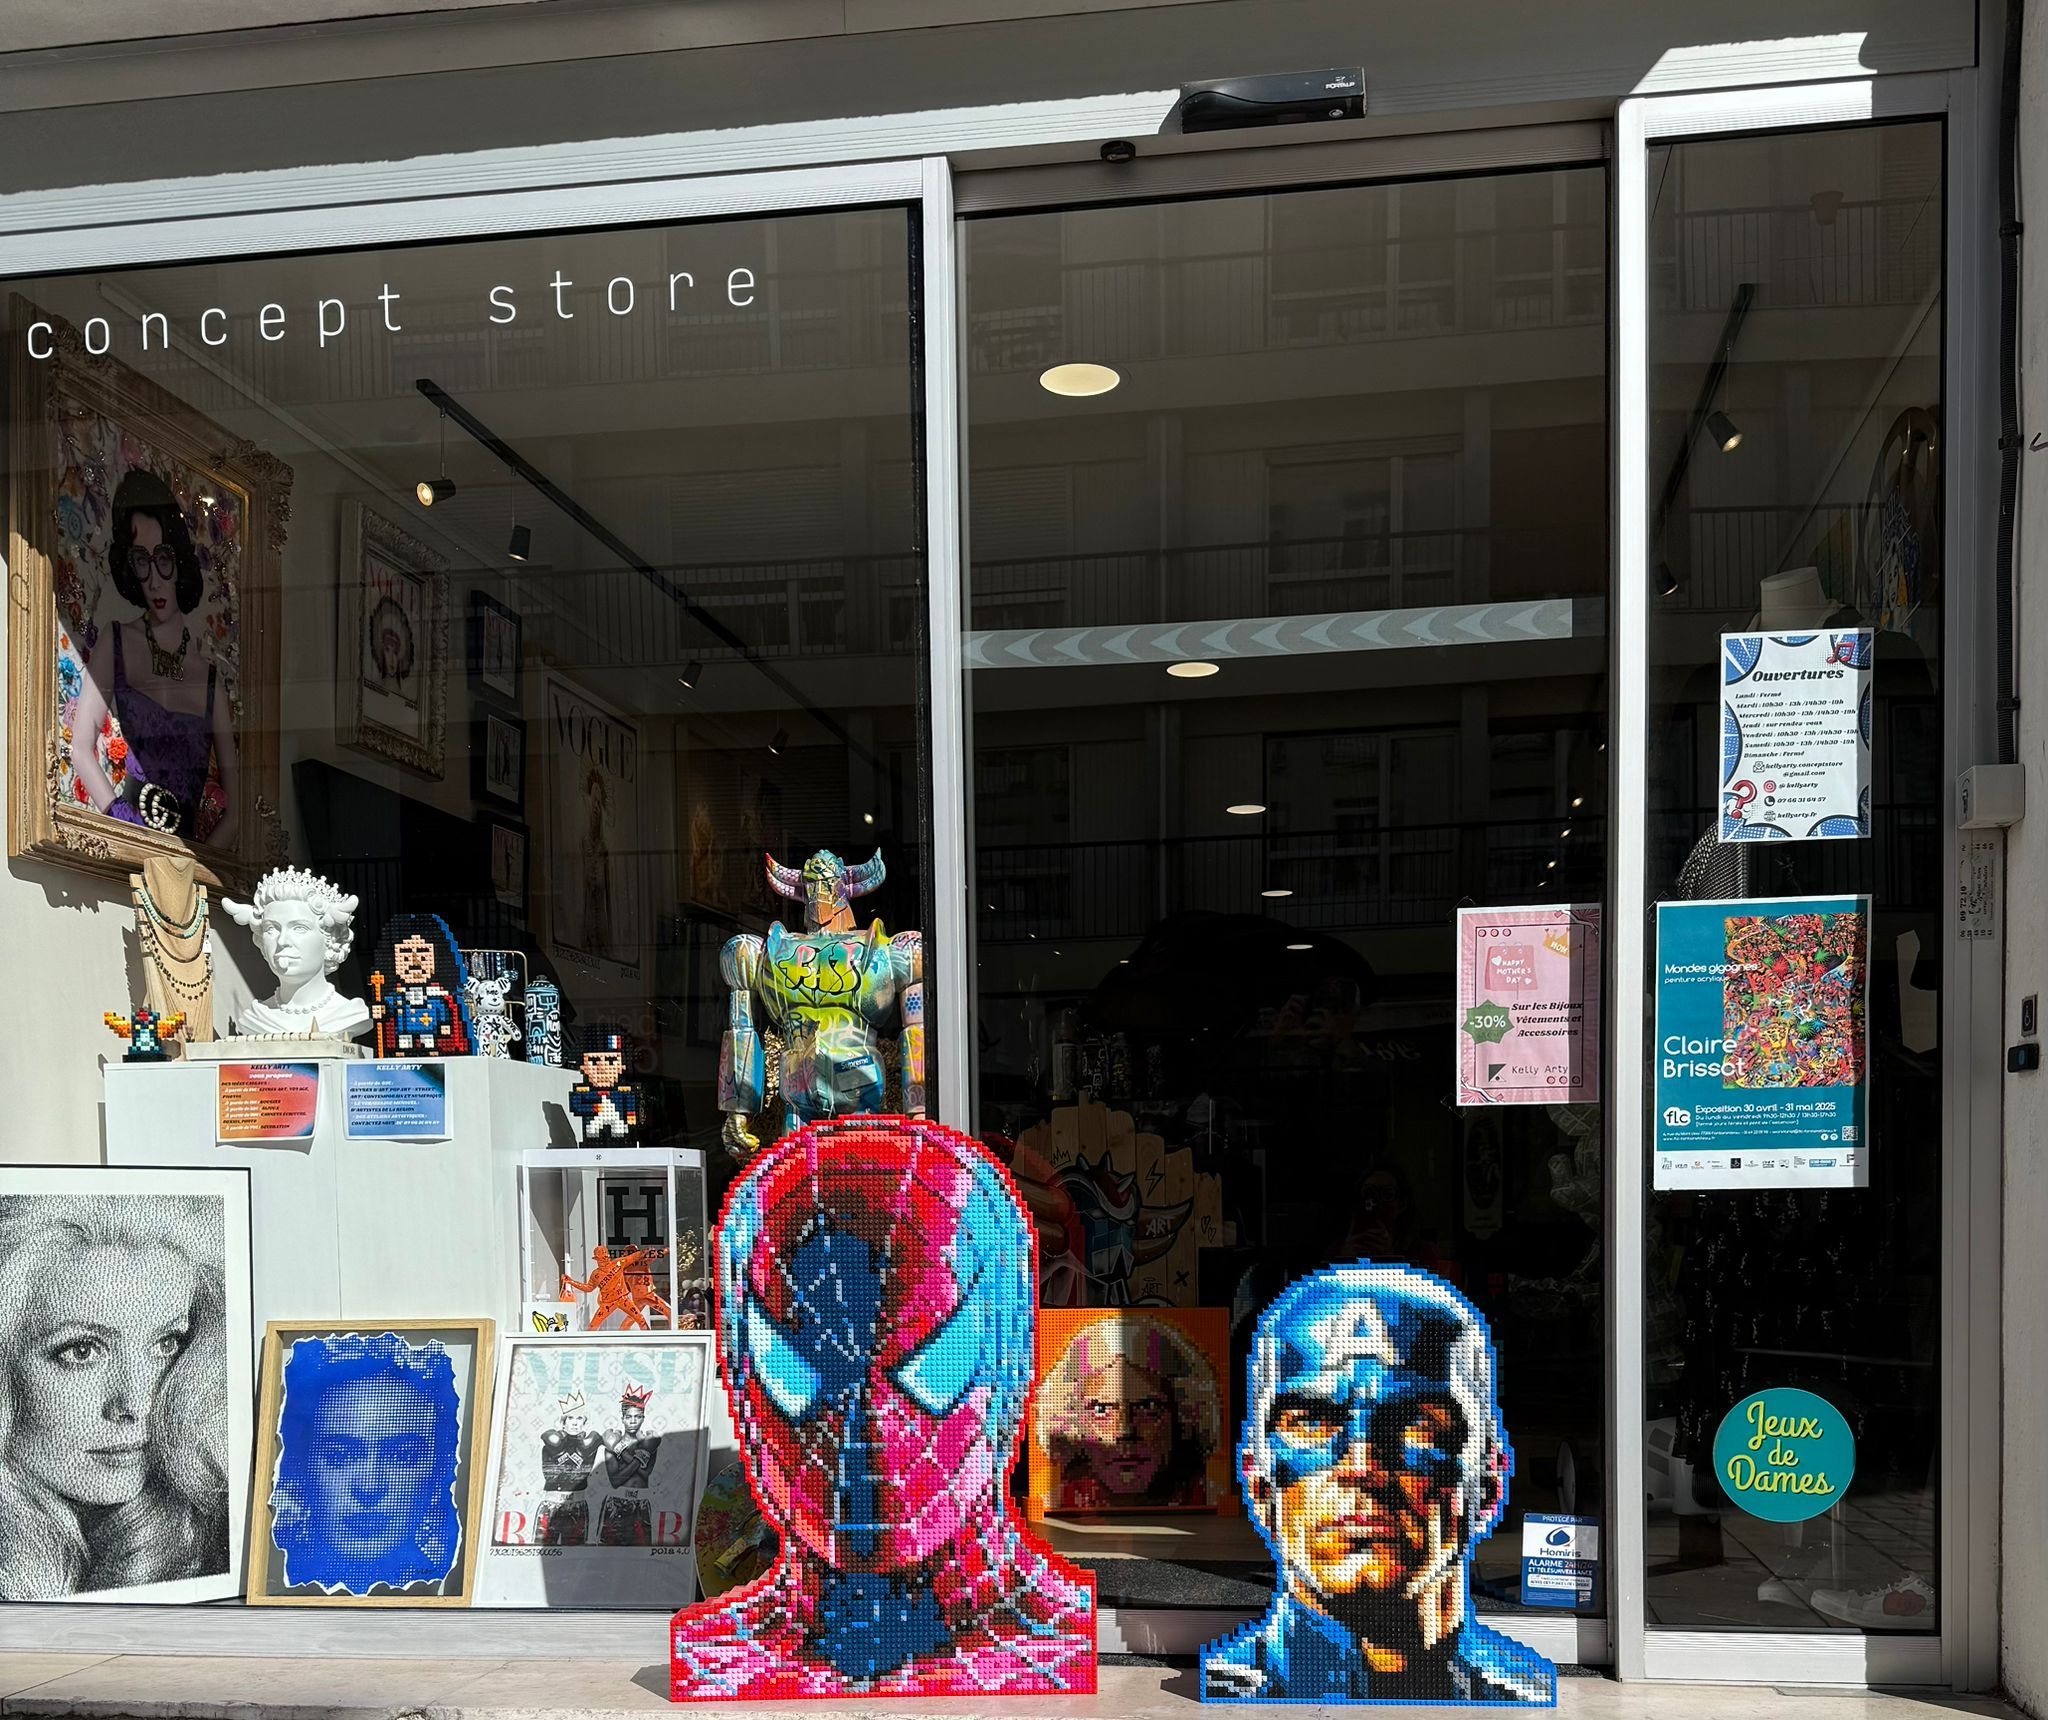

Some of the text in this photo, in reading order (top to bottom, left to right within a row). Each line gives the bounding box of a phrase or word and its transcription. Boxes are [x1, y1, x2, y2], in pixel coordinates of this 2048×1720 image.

[27, 267, 755, 359] concept store
[1752, 669, 1844, 682] Ouvertures
[554, 694, 633, 783] VOGUE
[1502, 958, 1525, 966] HAPPY
[1664, 963, 1758, 974] Mondes gigognes
[1506, 976, 1521, 984] DAY
[1511, 1002, 1584, 1012] Sur les Bijoux
[1469, 1015, 1506, 1028] -30%
[1516, 1015, 1582, 1024] Vêtements et
[1517, 1029, 1578, 1037] Accessoires
[1664, 1035, 1737, 1055] Claire
[1511, 1064, 1568, 1075] Kelly Arty
[1663, 1057, 1746, 1078] Brissot
[1695, 1104, 1742, 1114] Exposition
[1743, 1104, 1755, 1112] 30
[1755, 1104, 1778, 1112] avril
[1785, 1103, 1794, 1111] 31
[1796, 1103, 1813, 1111] mai
[1814, 1102, 1836, 1111] 2025
[1666, 1110, 1688, 1124] flc
[607, 1186, 664, 1245] H
[1145, 1217, 1175, 1236] ART
[1747, 1400, 1823, 1451] Jeux
[1768, 1439, 1799, 1467] de
[1727, 1454, 1834, 1495] Dames
[1542, 1515, 1570, 1523] PROTÉGÉ
[650, 1547, 675, 1556] pola
[676, 1547, 690, 1555] 4.0
[1540, 1547, 1581, 1558] Homiris
[1528, 1558, 1563, 1568] ALARME
[1537, 1566, 1592, 1576] TÉLÉSURVEILLANCE
